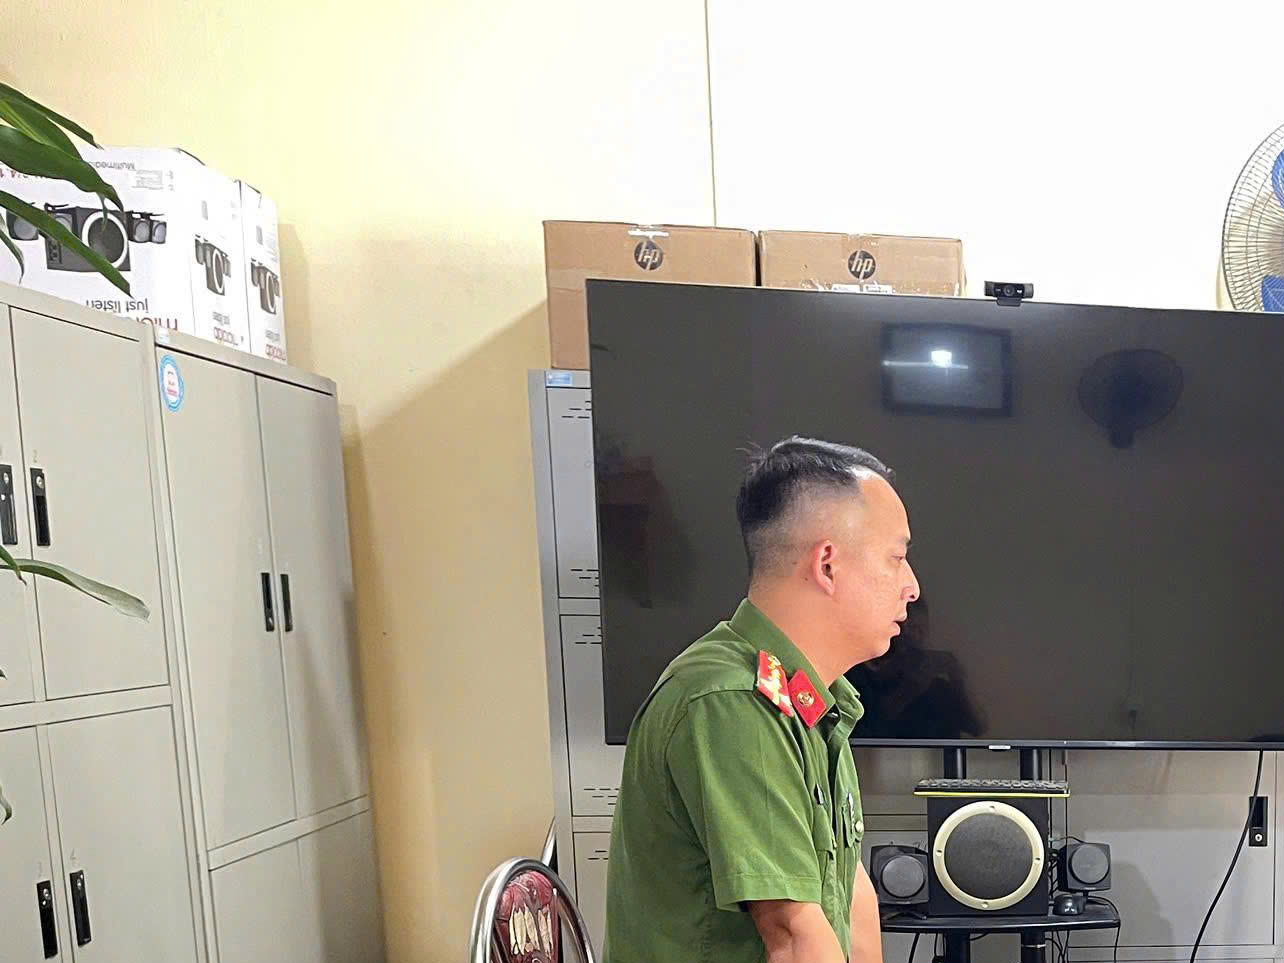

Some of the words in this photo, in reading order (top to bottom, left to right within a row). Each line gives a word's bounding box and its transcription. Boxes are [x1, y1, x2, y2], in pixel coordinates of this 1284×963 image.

[637, 241, 660, 270] hp
[851, 250, 873, 280] hp
[126, 298, 149, 314] just
